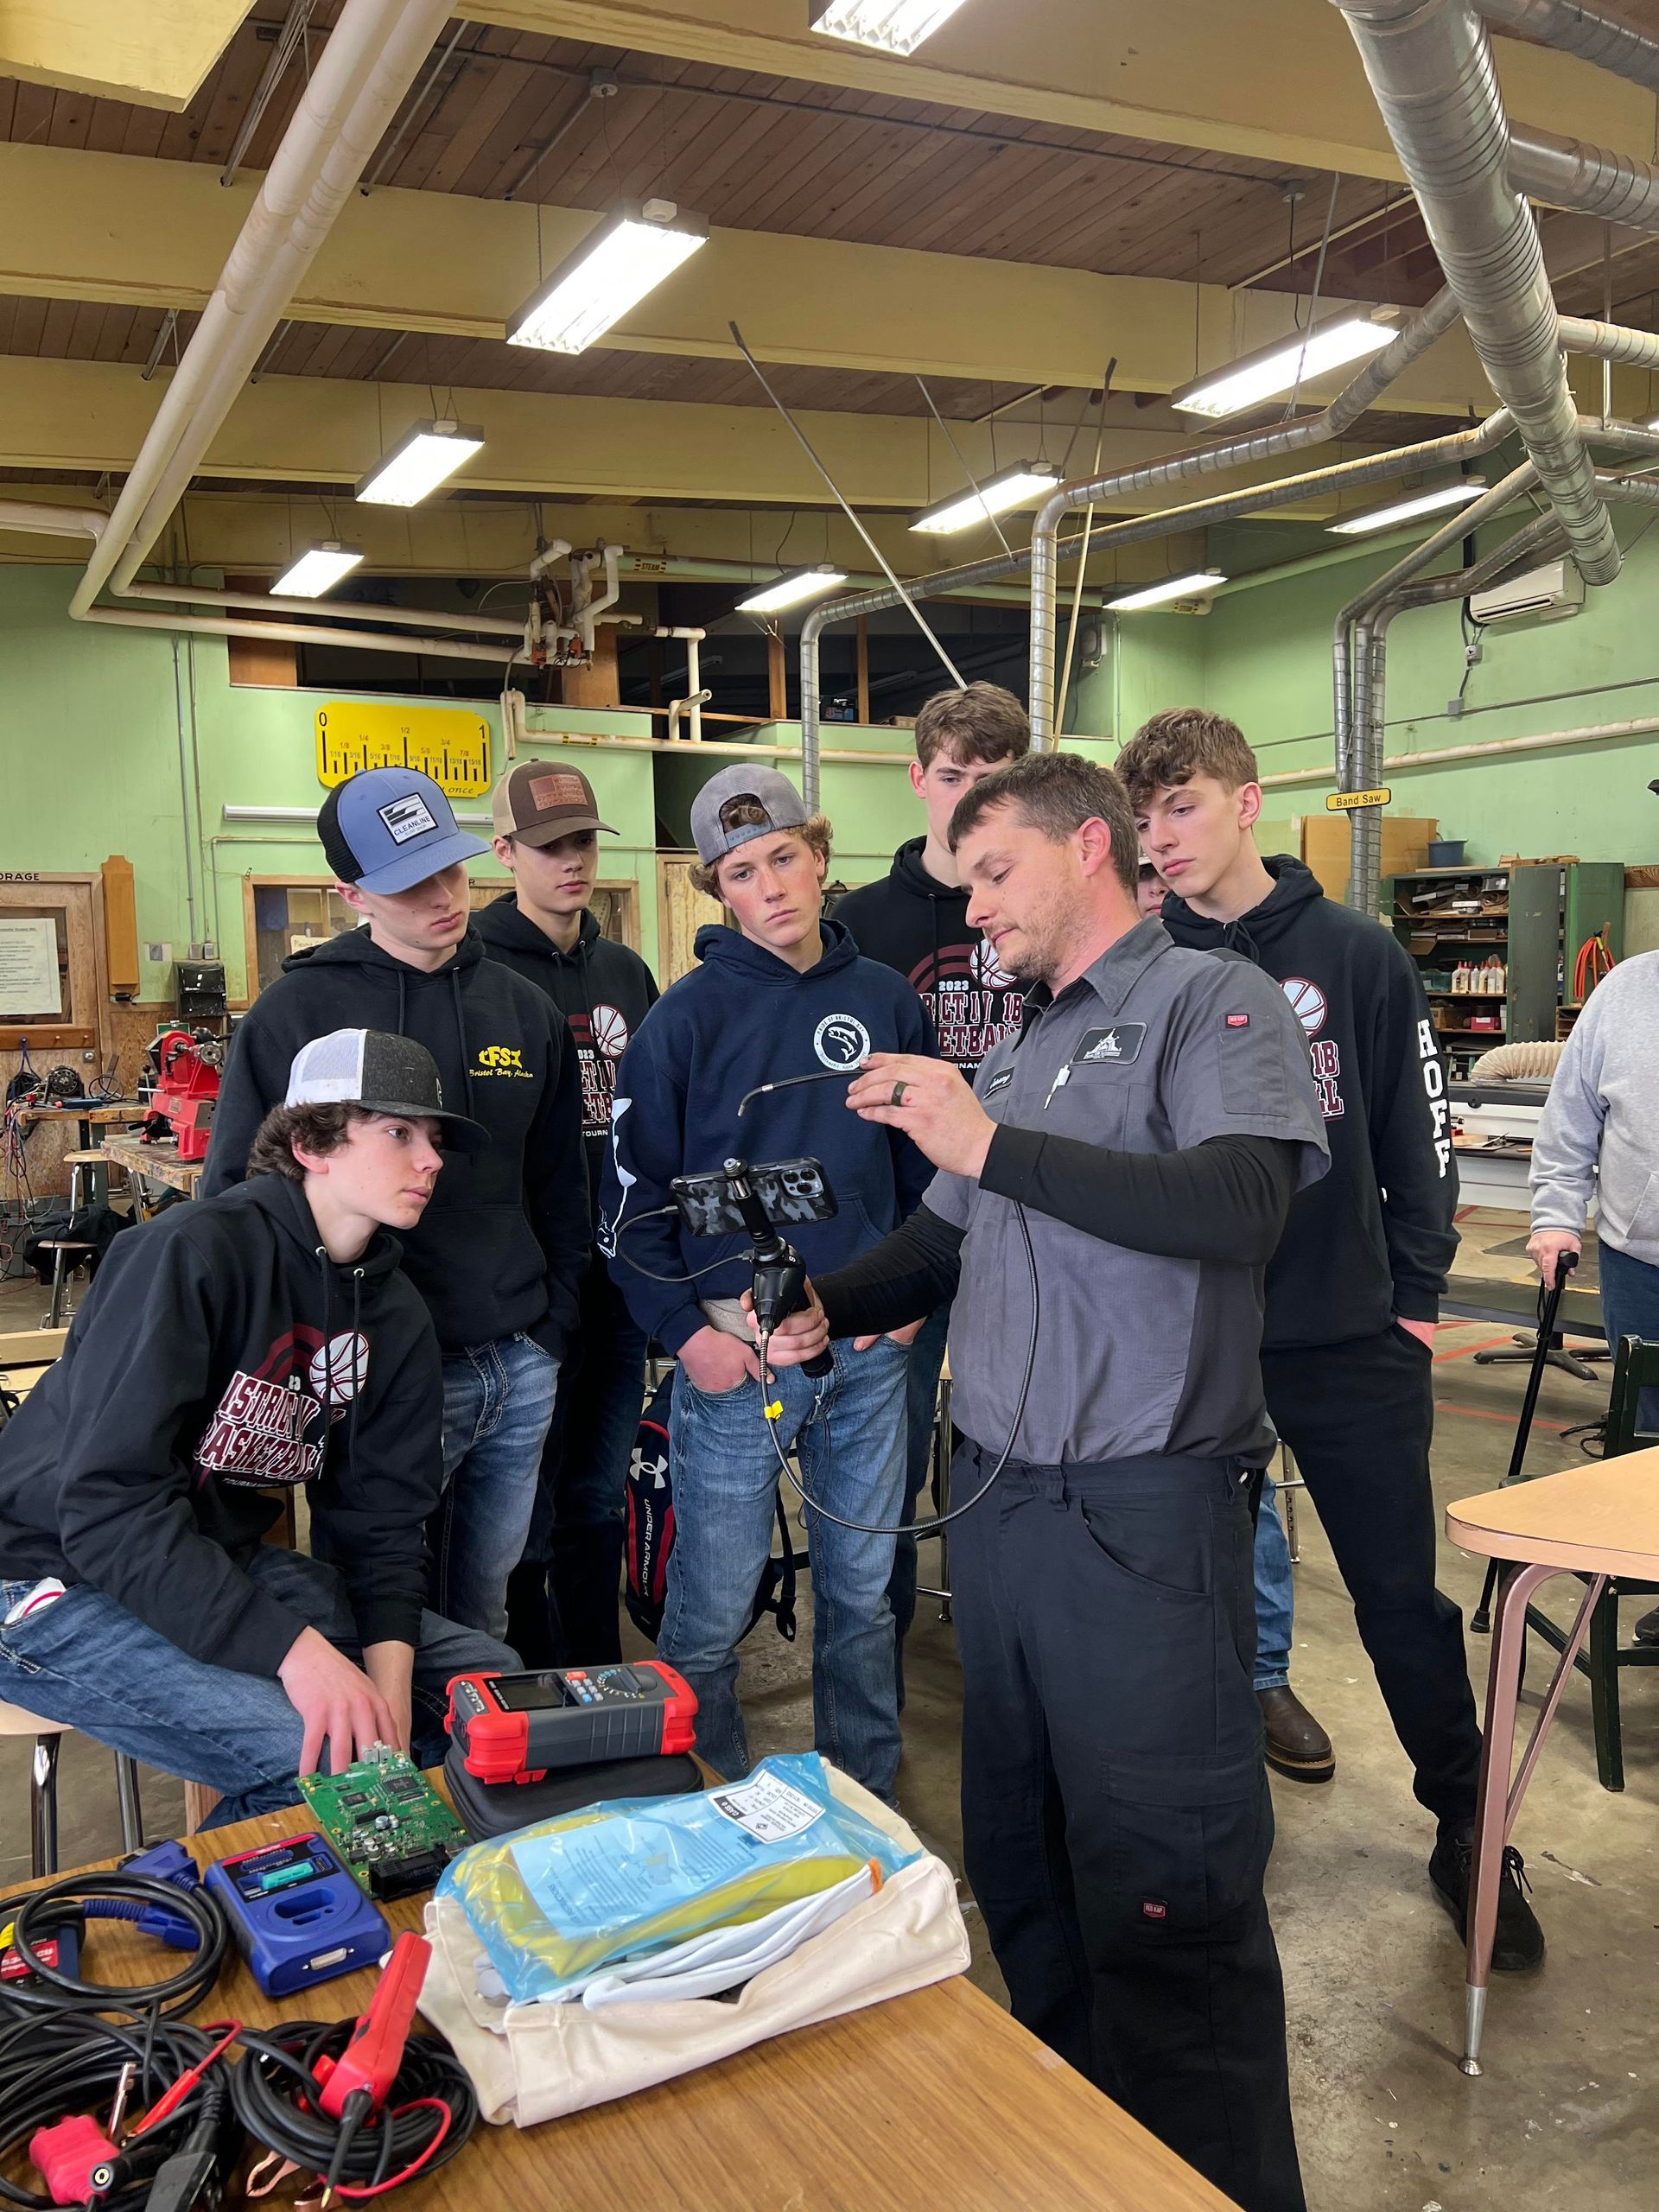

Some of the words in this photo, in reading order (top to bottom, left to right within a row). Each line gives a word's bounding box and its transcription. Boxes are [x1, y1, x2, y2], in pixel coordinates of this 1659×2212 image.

[319, 712, 327, 727] 0
[479, 724, 486, 739] 1
[1336, 796, 1359, 807] Band
[1362, 794, 1382, 804] Saw
[394, 816, 430, 836] CLEANLINE
[938, 981, 969, 991] 2023
[578, 1049, 595, 1060] 023
[1310, 1040, 1340, 1079] 1B
[469, 1069, 493, 1077] Bristol
[514, 1069, 534, 1078] Alaska
[1417, 1019, 1451, 1179] HOFF
[644, 1498, 653, 1541] UNDER
